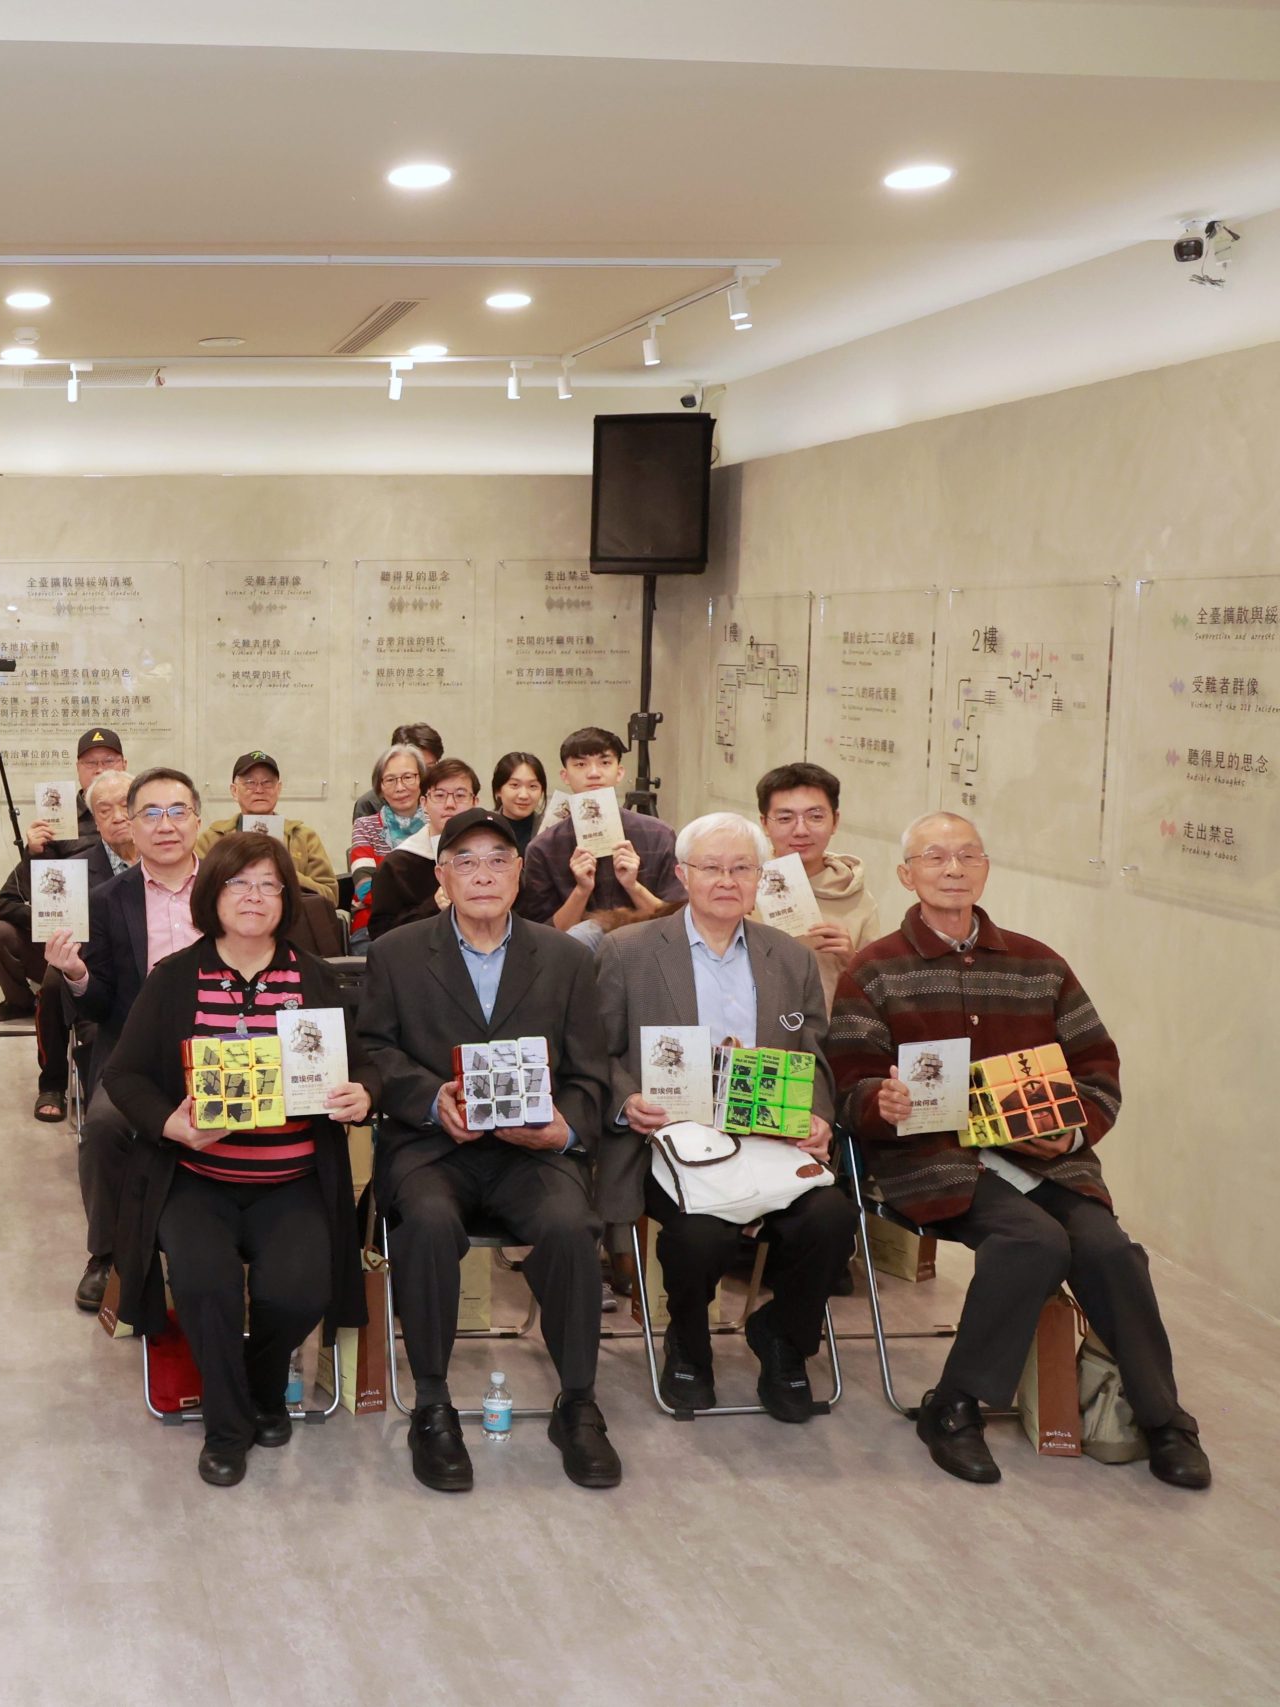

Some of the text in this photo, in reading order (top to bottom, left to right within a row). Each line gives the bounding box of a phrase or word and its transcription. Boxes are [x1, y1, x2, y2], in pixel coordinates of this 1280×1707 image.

[244, 576, 302, 586] 受難者群像
[381, 571, 450, 582] 聽得見的思念
[545, 571, 590, 581] 走出禁忌
[27, 577, 133, 588] 全臺擴散與綏靖清鄉
[232, 639, 281, 648] 受難者群像
[377, 637, 445, 646] 音樂背後的時代
[516, 636, 594, 645] 民間的呼籲與行動
[972, 625, 999, 653] 2樓
[0, 642, 60, 652] 各地抗爭行動
[377, 668, 445, 677] 親族的思念之聲
[516, 668, 594, 677] 官方的回應與作為
[1192, 676, 1259, 696] 受難者群像
[0, 708, 130, 717] 與行政長官公署改制為省政府
[1, 750, 70, 759] 情治單位的角色
[1187, 749, 1268, 773] 聽得見的思念
[1184, 821, 1234, 845] 走出禁忌
